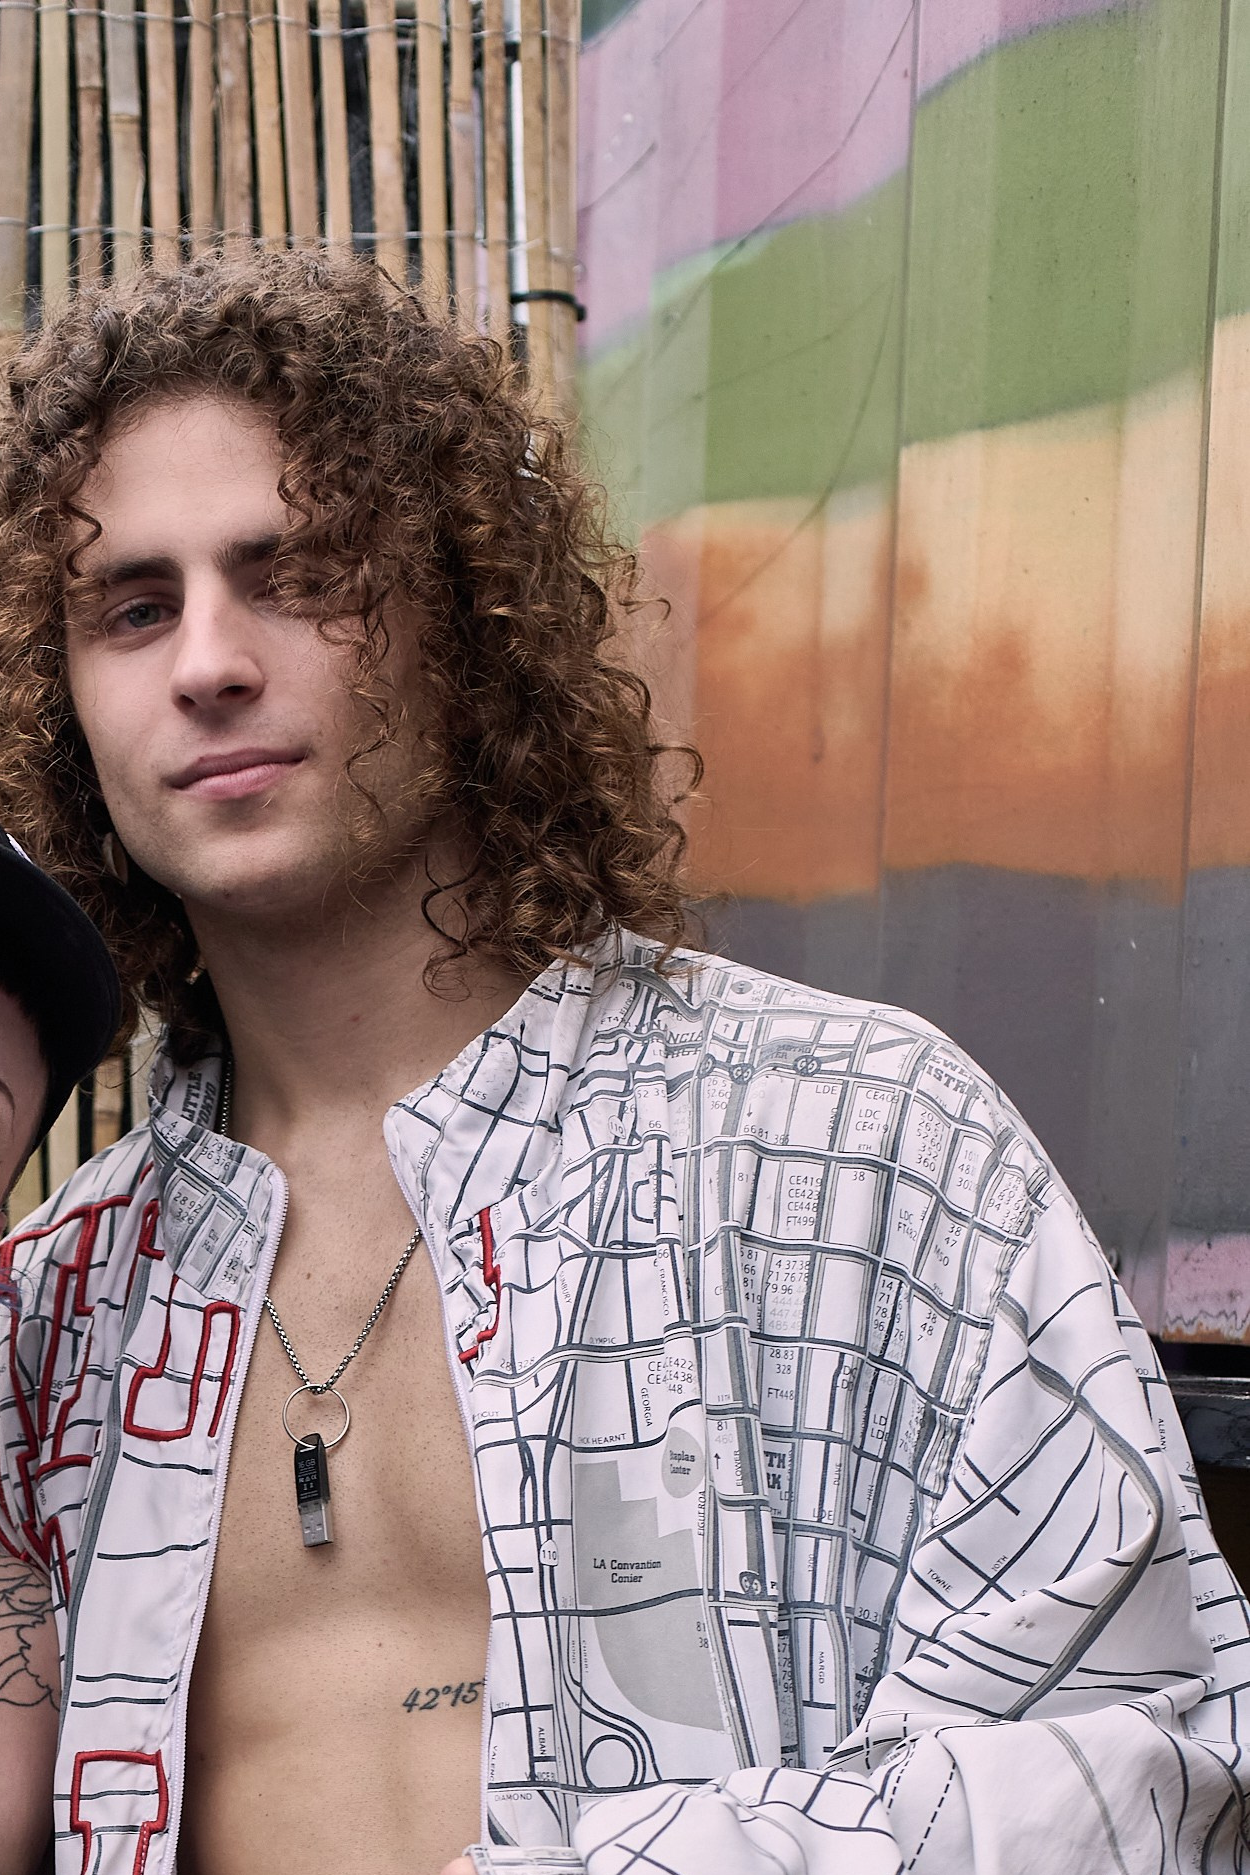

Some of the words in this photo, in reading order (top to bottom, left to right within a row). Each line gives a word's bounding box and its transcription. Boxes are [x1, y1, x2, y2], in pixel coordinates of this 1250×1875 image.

[815, 1084, 838, 1095] LDE
[859, 1109, 881, 1119] LDC
[648, 1120, 662, 1129] 66
[855, 1120, 889, 1133] CE419
[852, 1170, 865, 1181] 38
[786, 1215, 815, 1227] FT499
[948, 1223, 961, 1237] 38
[776, 1363, 792, 1375] 328
[767, 1387, 795, 1401] FT448
[640, 1386, 653, 1428] GEORGIA
[716, 1421, 729, 1431] 81
[542, 1550, 557, 1561] 110
[593, 1558, 607, 1570] LA
[926, 1567, 953, 1593] TOWNE
